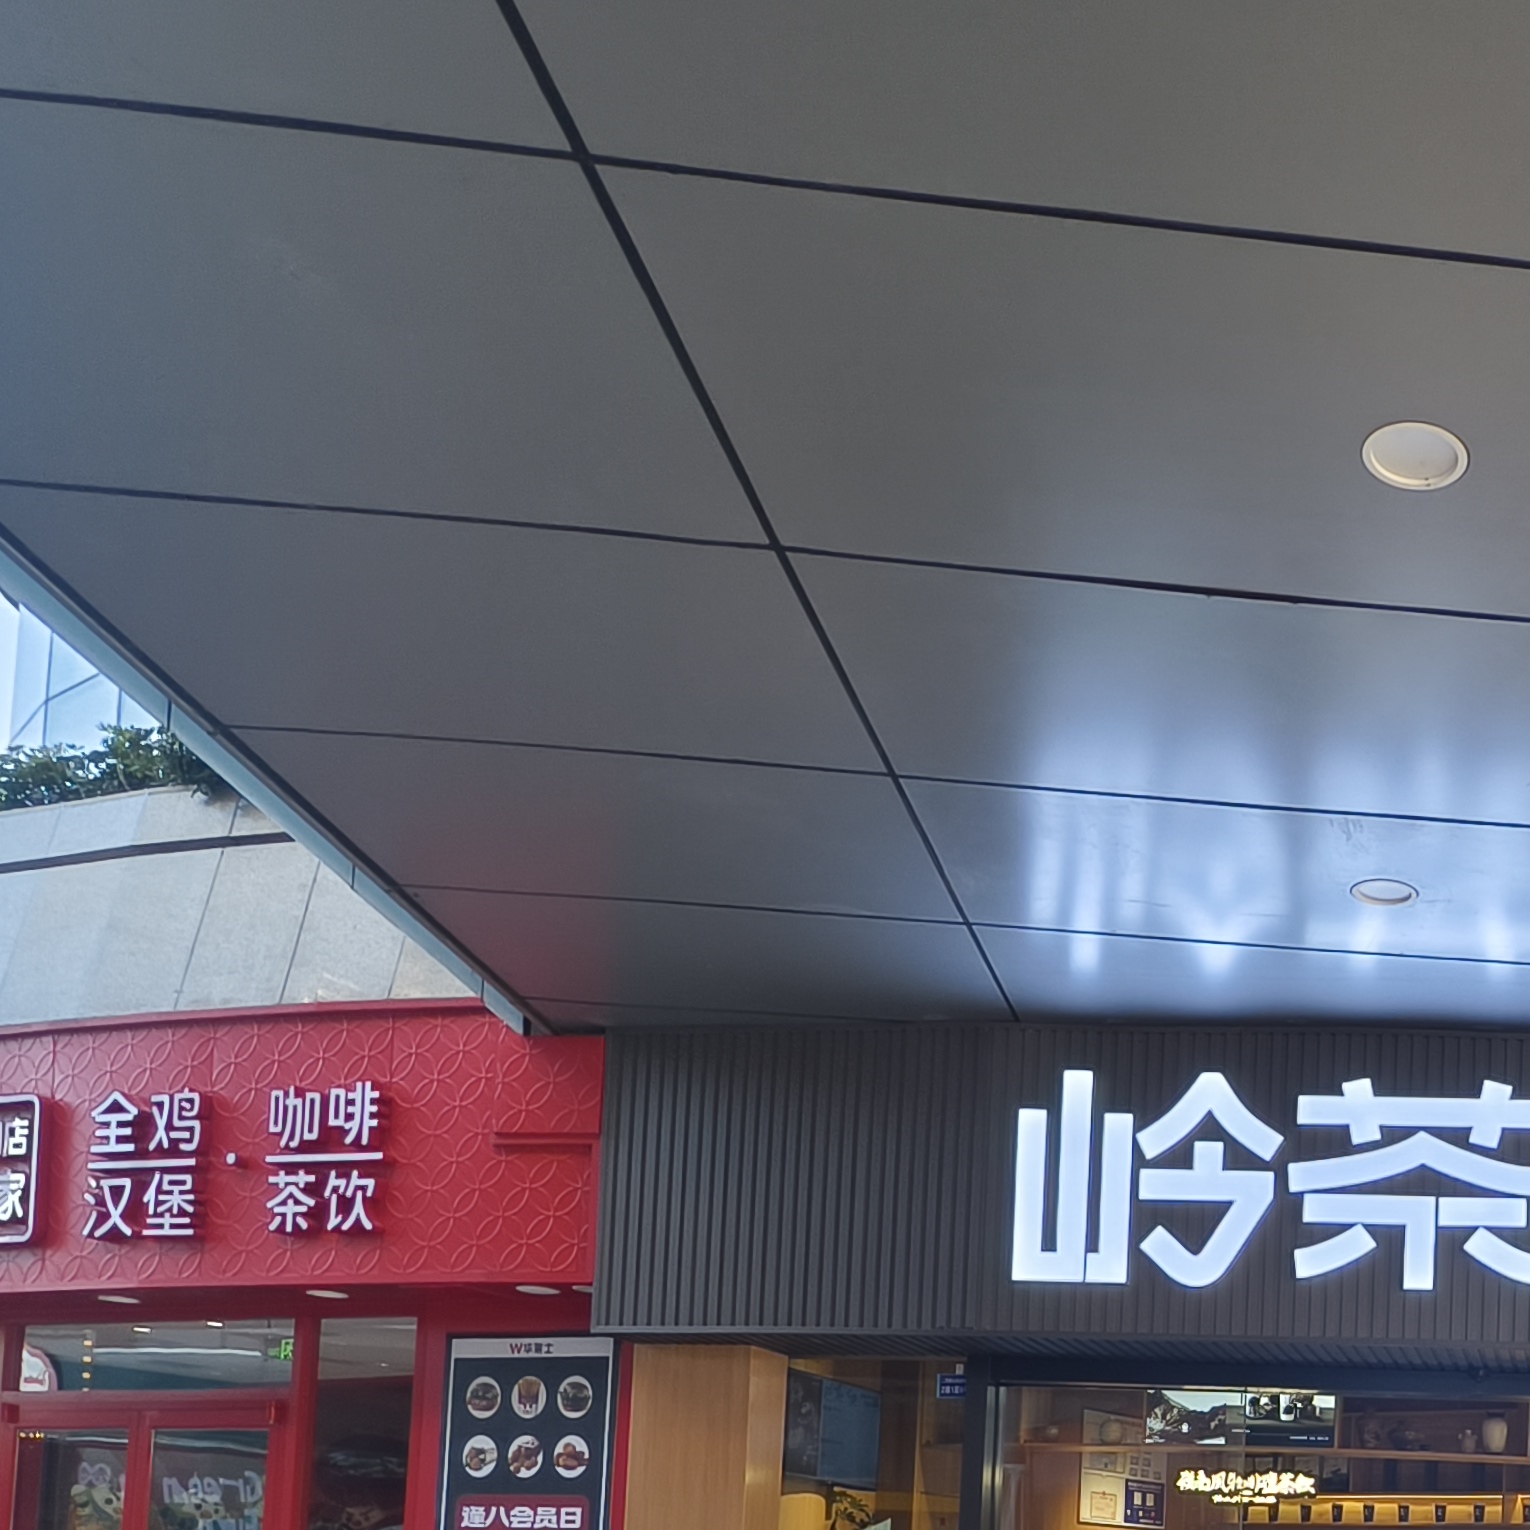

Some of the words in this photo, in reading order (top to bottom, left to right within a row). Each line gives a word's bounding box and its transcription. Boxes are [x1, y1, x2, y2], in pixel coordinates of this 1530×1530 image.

[0, 1117, 29, 1156] 店
[90, 1088, 200, 1153] 全鸡
[268, 1081, 380, 1149] 咖啡
[82, 1171, 195, 1238] 汉堡
[266, 1170, 376, 1232] 茶饮
